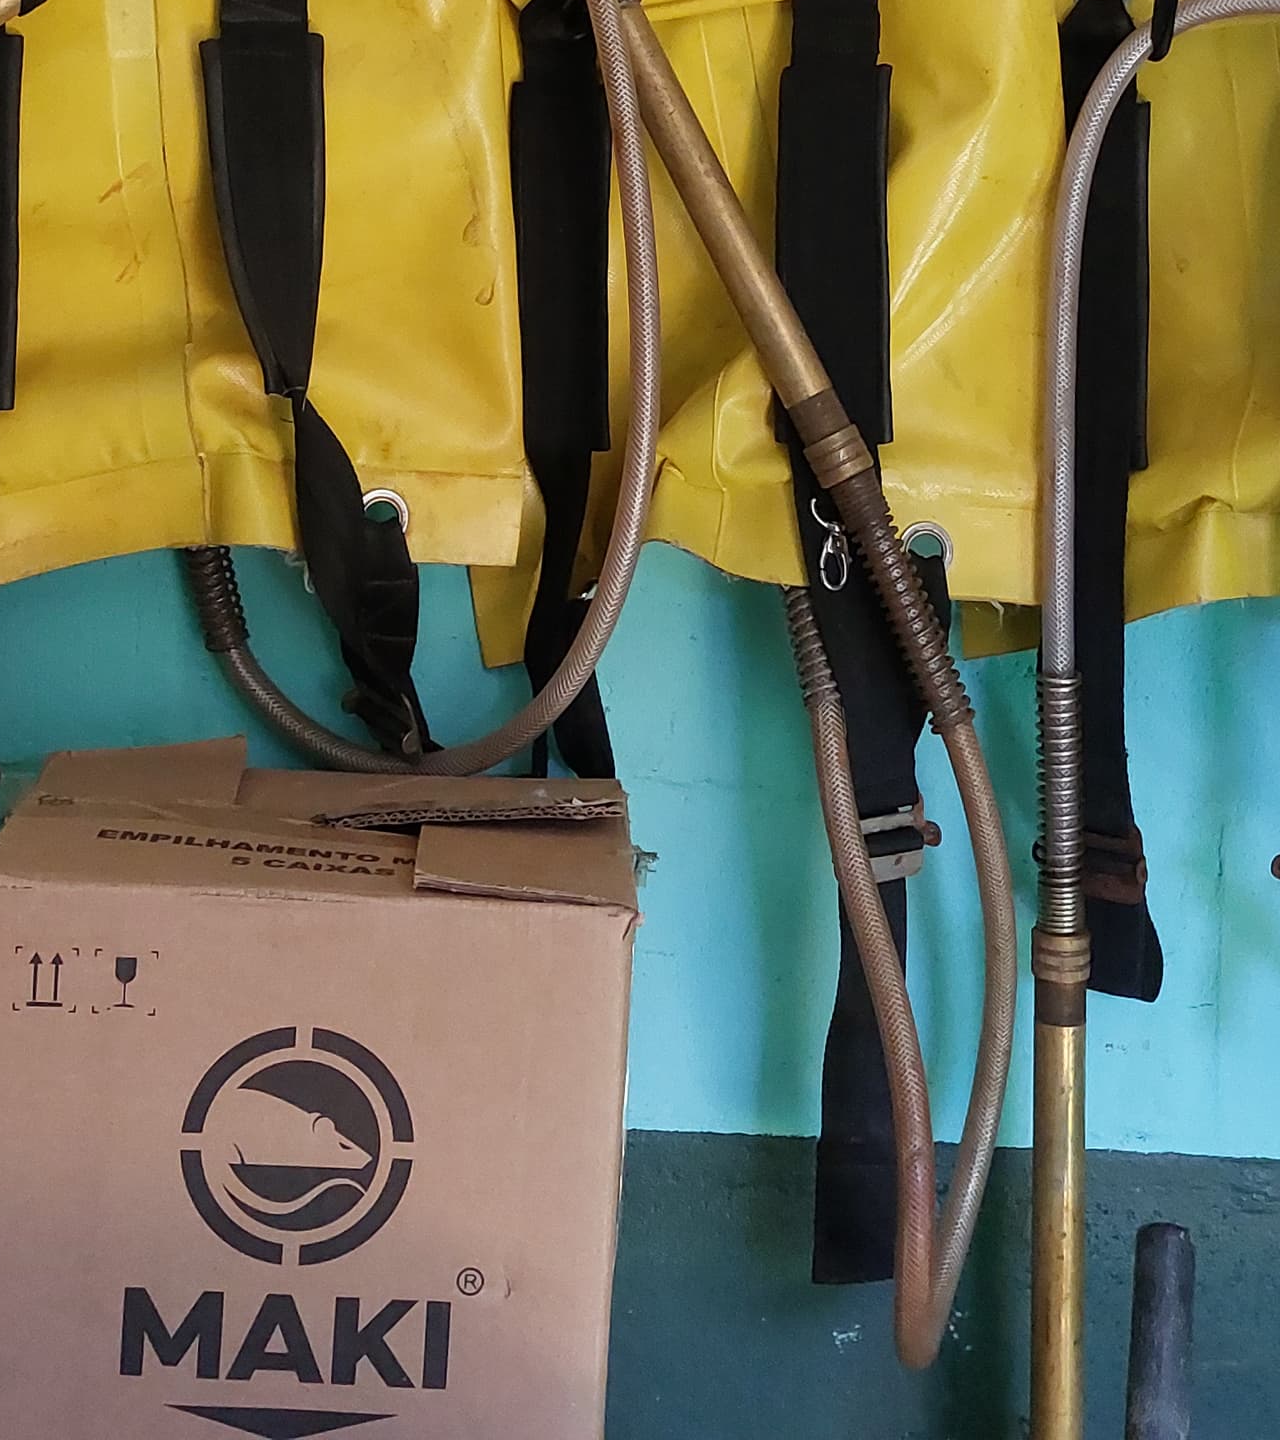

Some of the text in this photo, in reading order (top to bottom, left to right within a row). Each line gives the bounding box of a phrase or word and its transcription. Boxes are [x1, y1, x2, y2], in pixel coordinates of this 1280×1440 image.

[96, 828, 417, 865] EMPILHAMENTO M
[230, 856, 396, 877] 5 CAIXAS
[119, 1286, 453, 1390] MAKI
